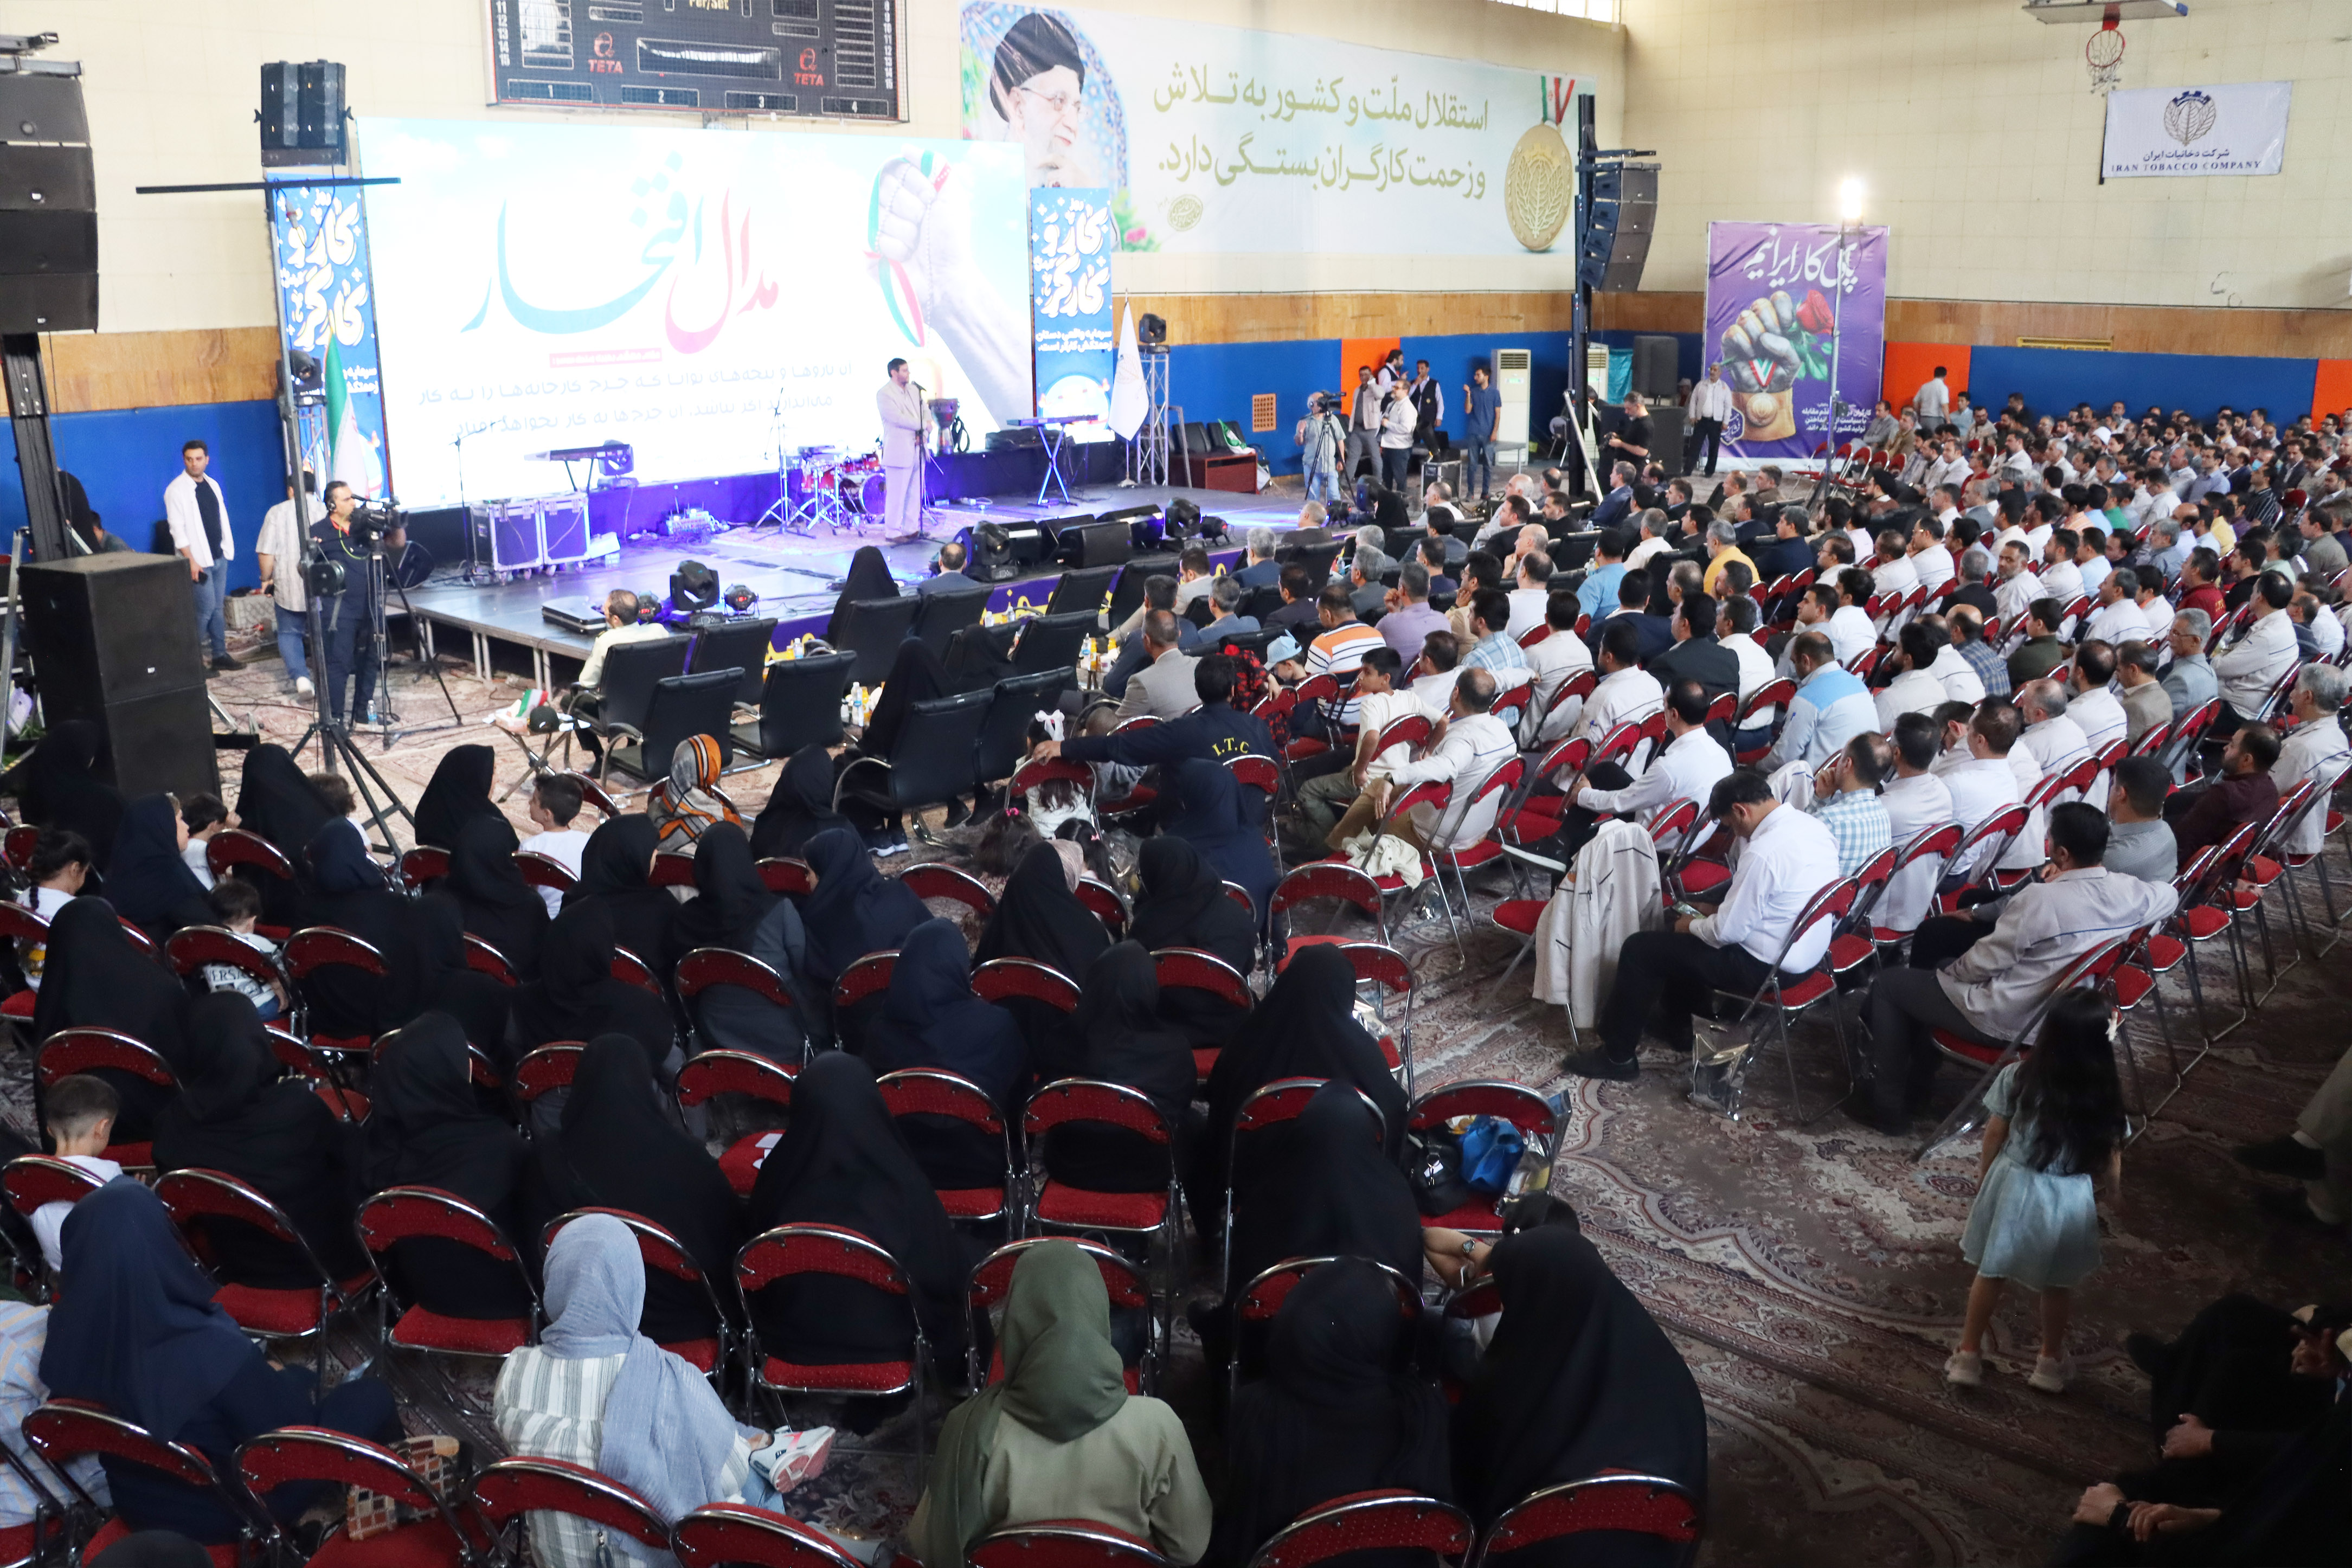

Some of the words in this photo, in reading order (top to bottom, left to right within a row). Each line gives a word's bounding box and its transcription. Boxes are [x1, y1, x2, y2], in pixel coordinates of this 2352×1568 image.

[588, 59, 623, 73] TETA
[794, 73, 824, 86] TETA
[1153, 62, 1238, 112] تلاش
[548, 85, 554, 98] 1
[658, 90, 664, 103] 2
[1242, 77, 1266, 121] به
[1269, 76, 1343, 122] کشور
[759, 95, 764, 108] 3
[852, 101, 857, 113] 4
[1345, 95, 1359, 126] و
[1416, 91, 1488, 131] استقلال
[1159, 133, 1212, 182] دارد.
[1214, 132, 1319, 190] بستگی
[2143, 150, 2163, 162] ایران
[2165, 150, 2200, 159] دخانیات
[2202, 149, 2229, 159] شرکت
[1321, 143, 1408, 192] کارگران
[2143, 163, 2198, 171] TOBACCO
[2202, 160, 2261, 169] COMPANY
[460, 151, 705, 335] افتخار
[1743, 227, 1799, 288] ایرانیم
[1788, 232, 1841, 283] کار
[665, 187, 779, 354] مدال
[634, 374, 661, 388] که
[780, 367, 787, 380] و
[419, 388, 442, 406] کار
[481, 385, 493, 401] را
[565, 413, 587, 429] کار
[1212, 737, 1250, 756] I.T.C
